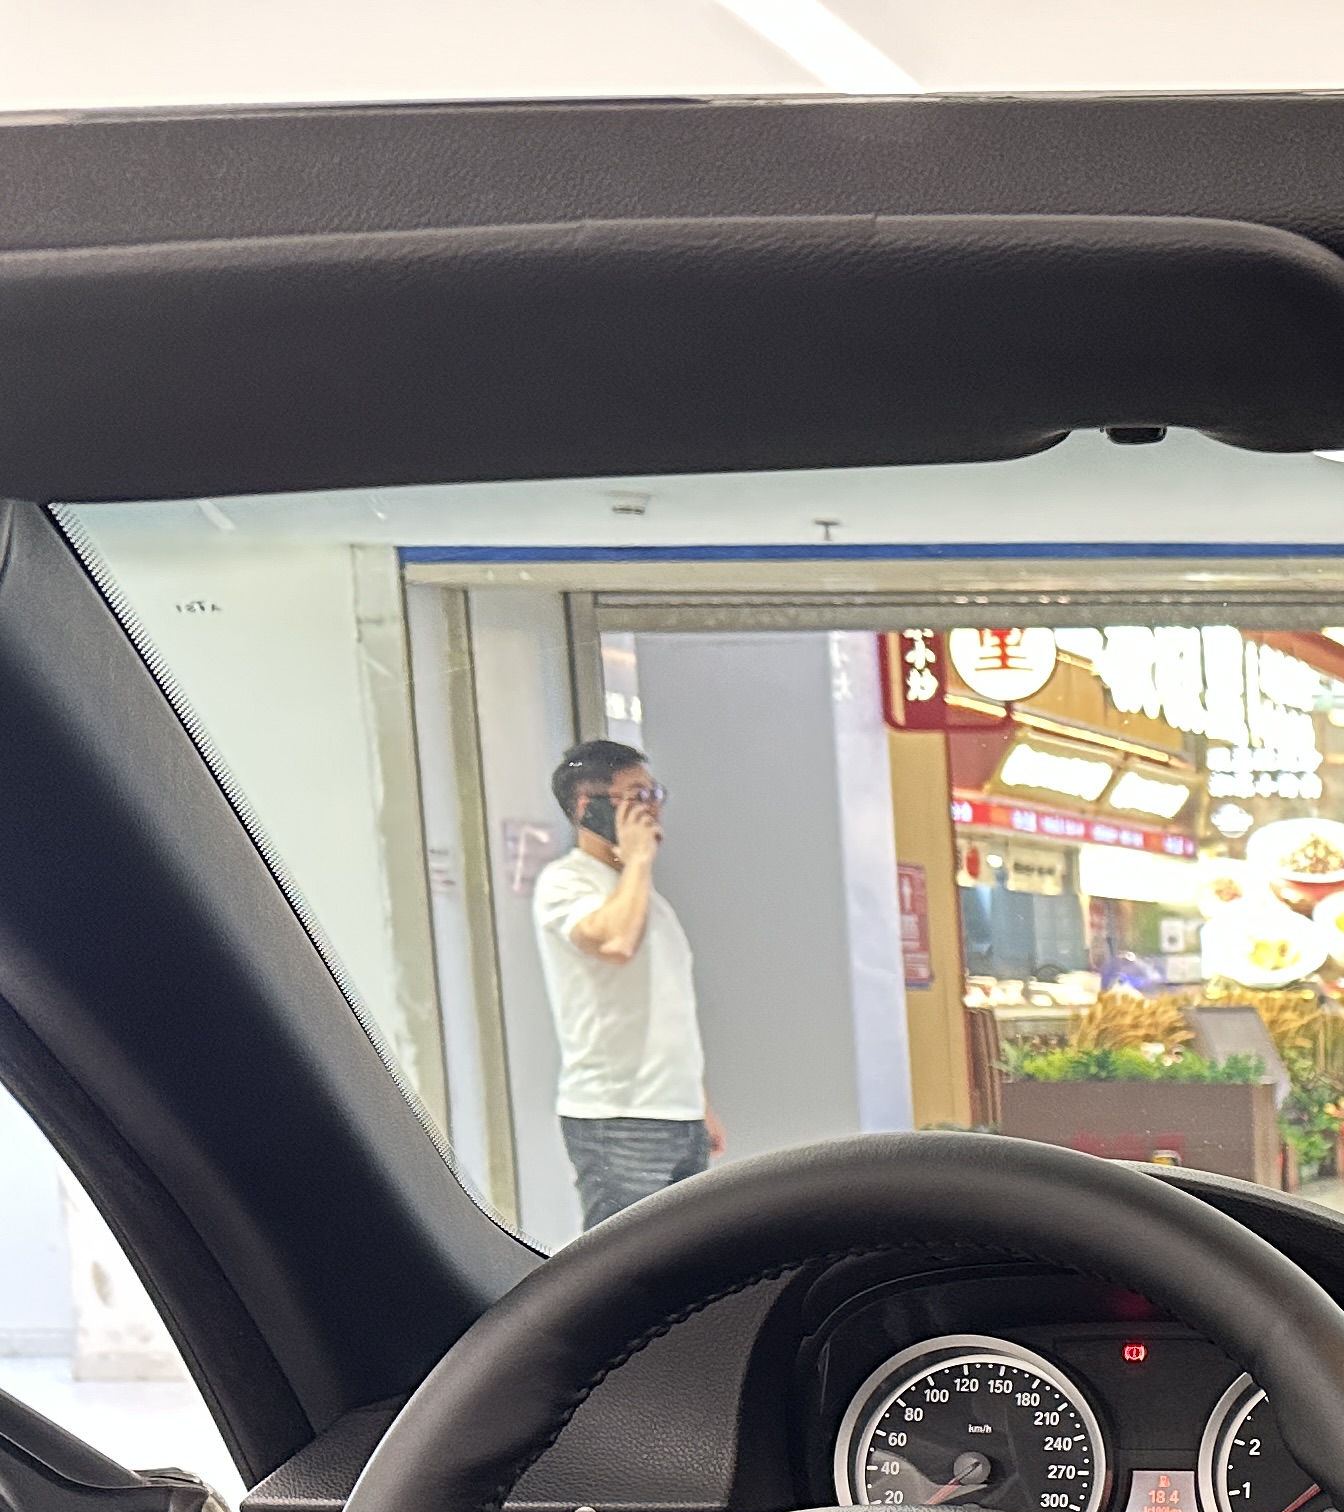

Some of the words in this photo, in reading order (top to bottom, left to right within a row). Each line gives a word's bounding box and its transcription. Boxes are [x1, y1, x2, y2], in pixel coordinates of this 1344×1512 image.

[954, 1378, 979, 1392] 120
[988, 1380, 1013, 1394] 150
[924, 1389, 949, 1403] 100
[1015, 1393, 1040, 1407] 180
[904, 1407, 923, 1421] 80
[1034, 1412, 1059, 1426] 210
[968, 1423, 992, 1433] km/h
[888, 1433, 907, 1447] 60
[1044, 1437, 1072, 1451] 240
[1249, 1439, 1261, 1456] 2
[881, 1461, 899, 1475] 40
[1047, 1465, 1076, 1479] 270
[1148, 1489, 1180, 1504] 18.4
[1242, 1482, 1251, 1498] 1
[885, 1491, 903, 1504] 20
[1040, 1494, 1069, 1508] 300
